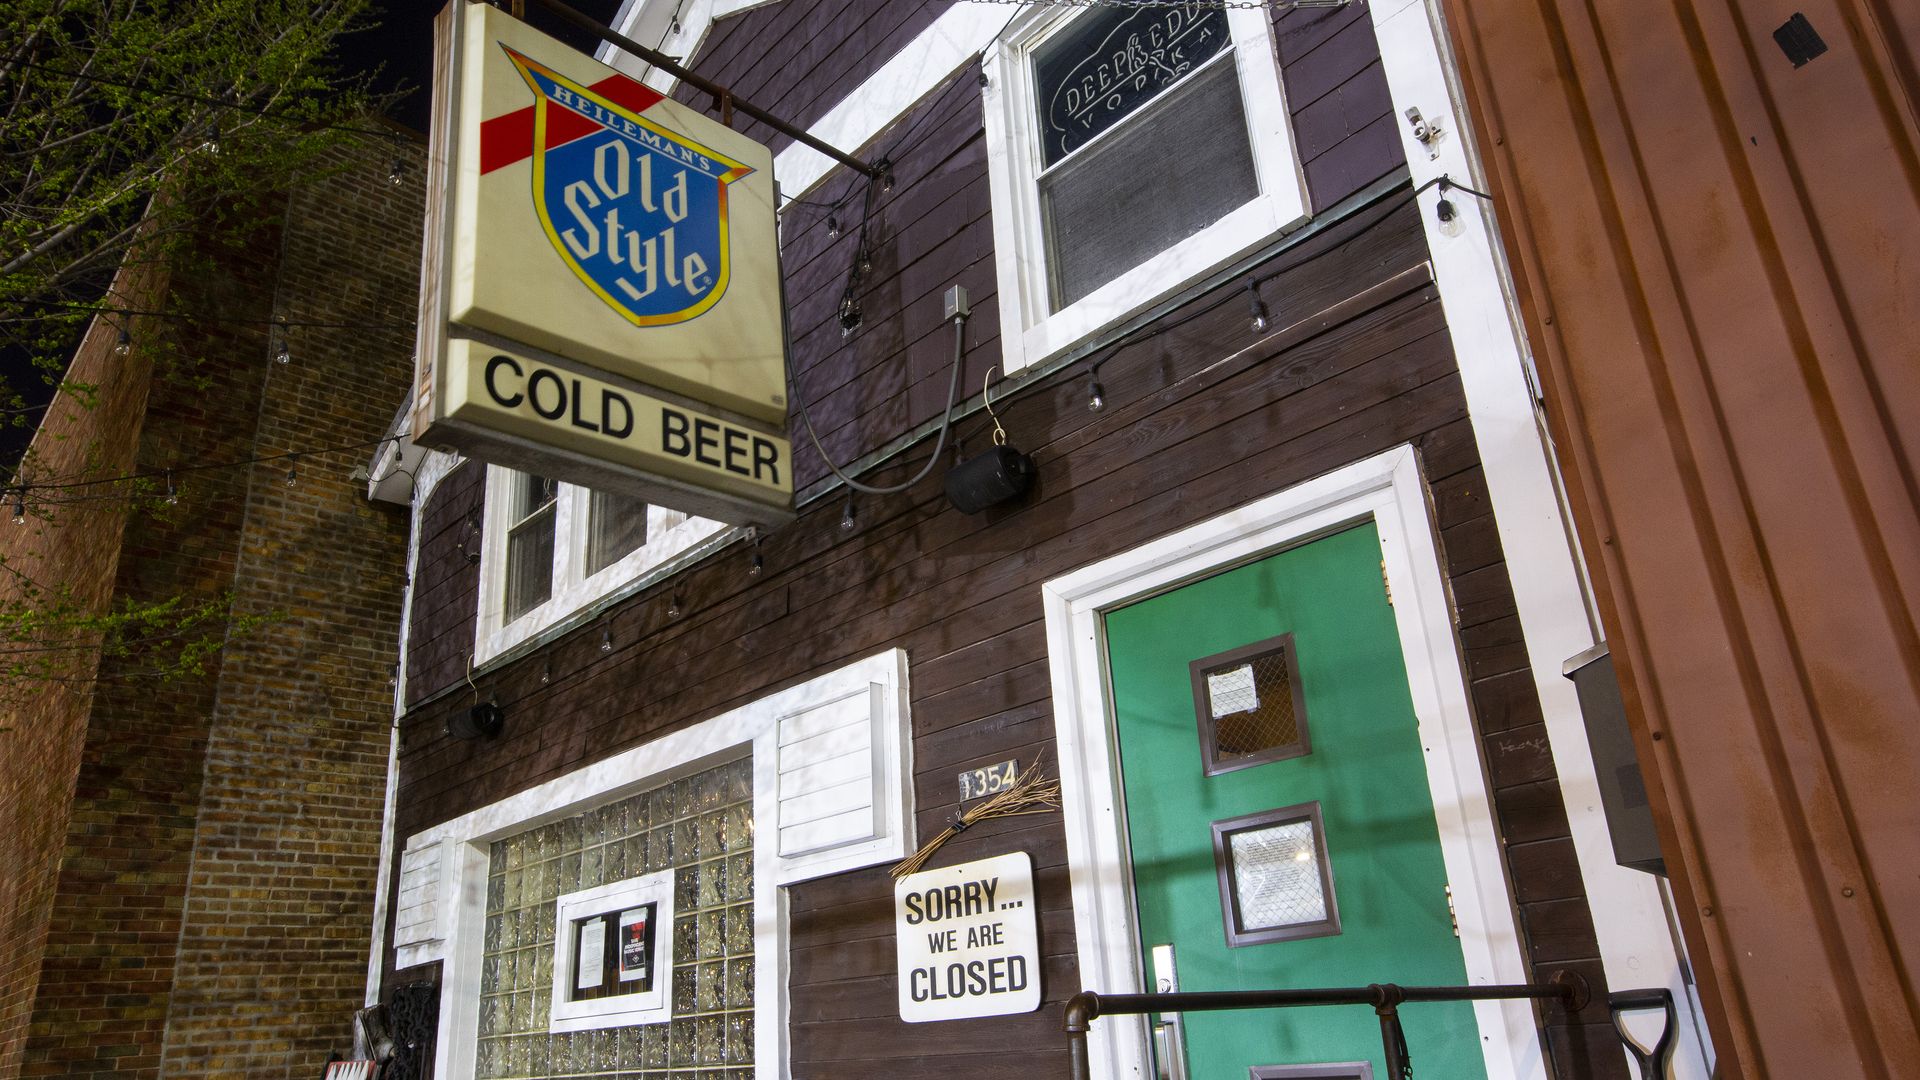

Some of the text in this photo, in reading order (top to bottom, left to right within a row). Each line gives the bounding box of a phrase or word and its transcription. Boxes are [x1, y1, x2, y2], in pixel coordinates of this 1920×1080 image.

[1066, 0, 1200, 117] DEEP EDD
[552, 84, 711, 171] HEILEMAN'S
[593, 139, 688, 223] Old
[561, 180, 708, 301] Style
[484, 355, 779, 485] COLD BEER
[905, 877, 1023, 925] SORRY...
[928, 922, 1004, 954] WE ARE
[910, 955, 1028, 1002] CLOSED
